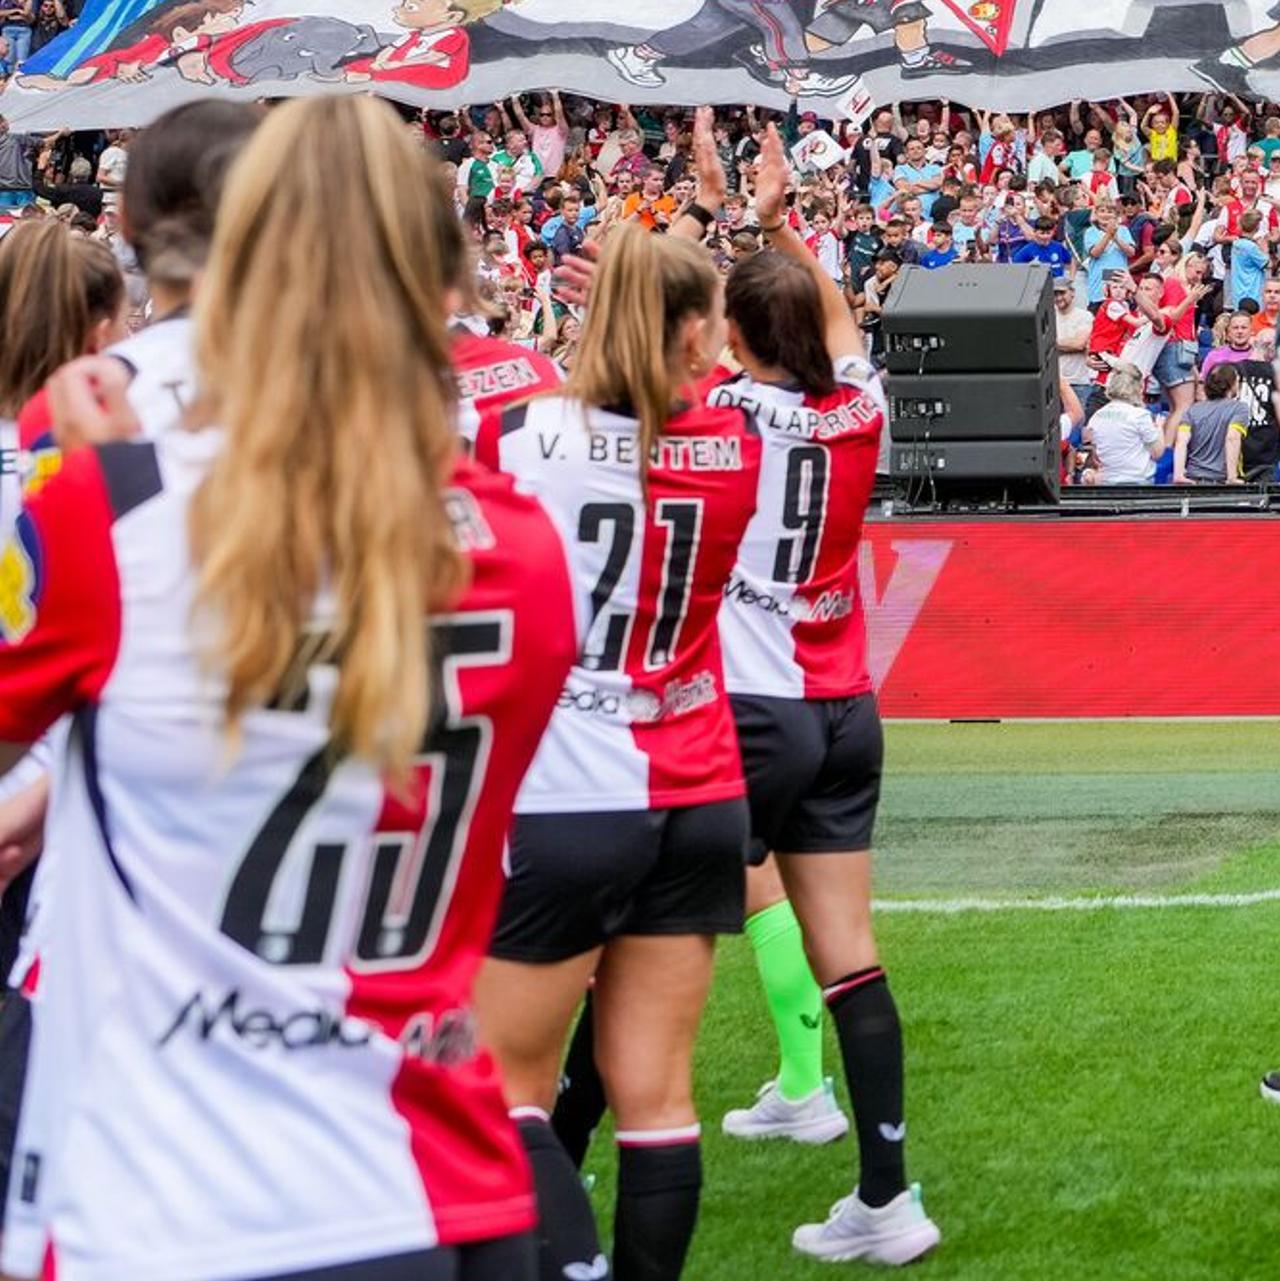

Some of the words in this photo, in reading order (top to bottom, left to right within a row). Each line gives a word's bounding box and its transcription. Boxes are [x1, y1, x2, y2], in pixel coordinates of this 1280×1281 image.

[538, 433, 568, 460] V.
[773, 445, 829, 585] 9
[577, 498, 704, 673] 21
[218, 609, 515, 976] 25
